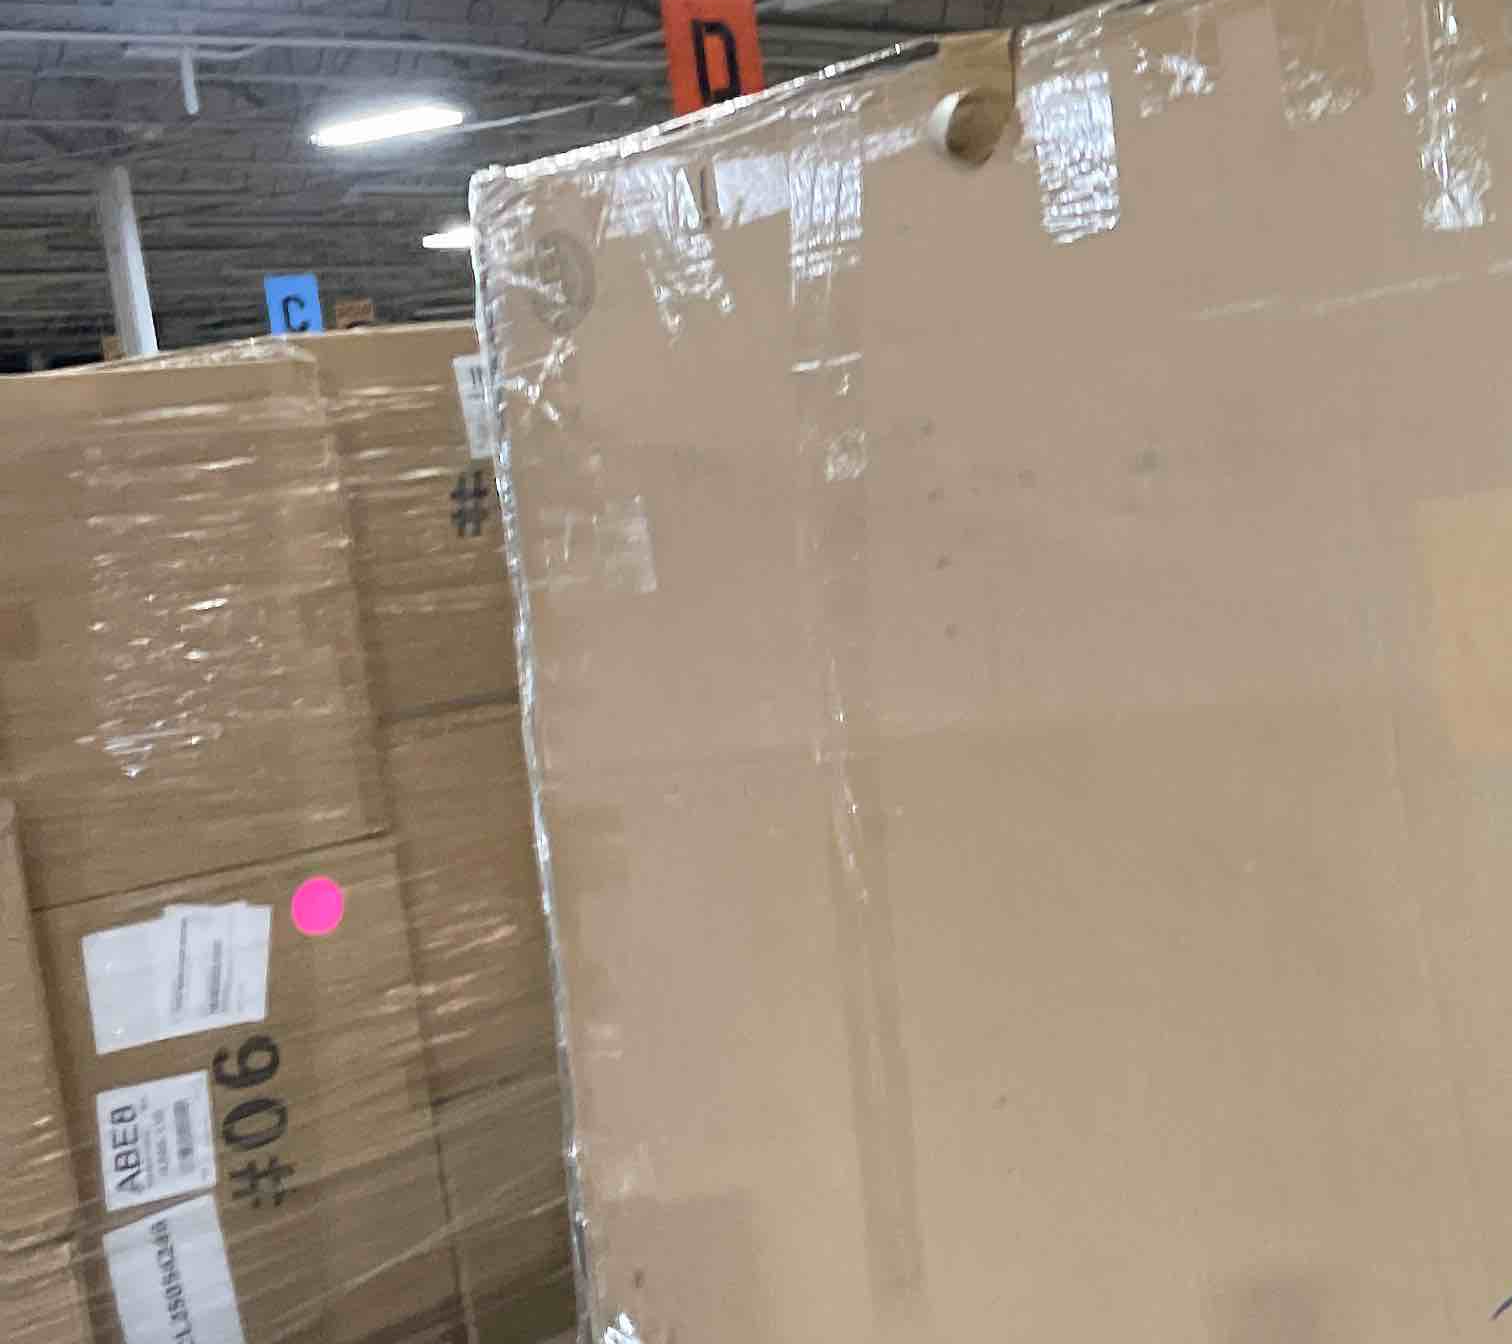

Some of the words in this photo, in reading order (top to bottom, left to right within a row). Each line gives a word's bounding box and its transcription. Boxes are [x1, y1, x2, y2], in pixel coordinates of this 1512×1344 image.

[691, 18, 742, 102] D
[282, 296, 310, 333] C
[213, 1035, 299, 1208] #06
